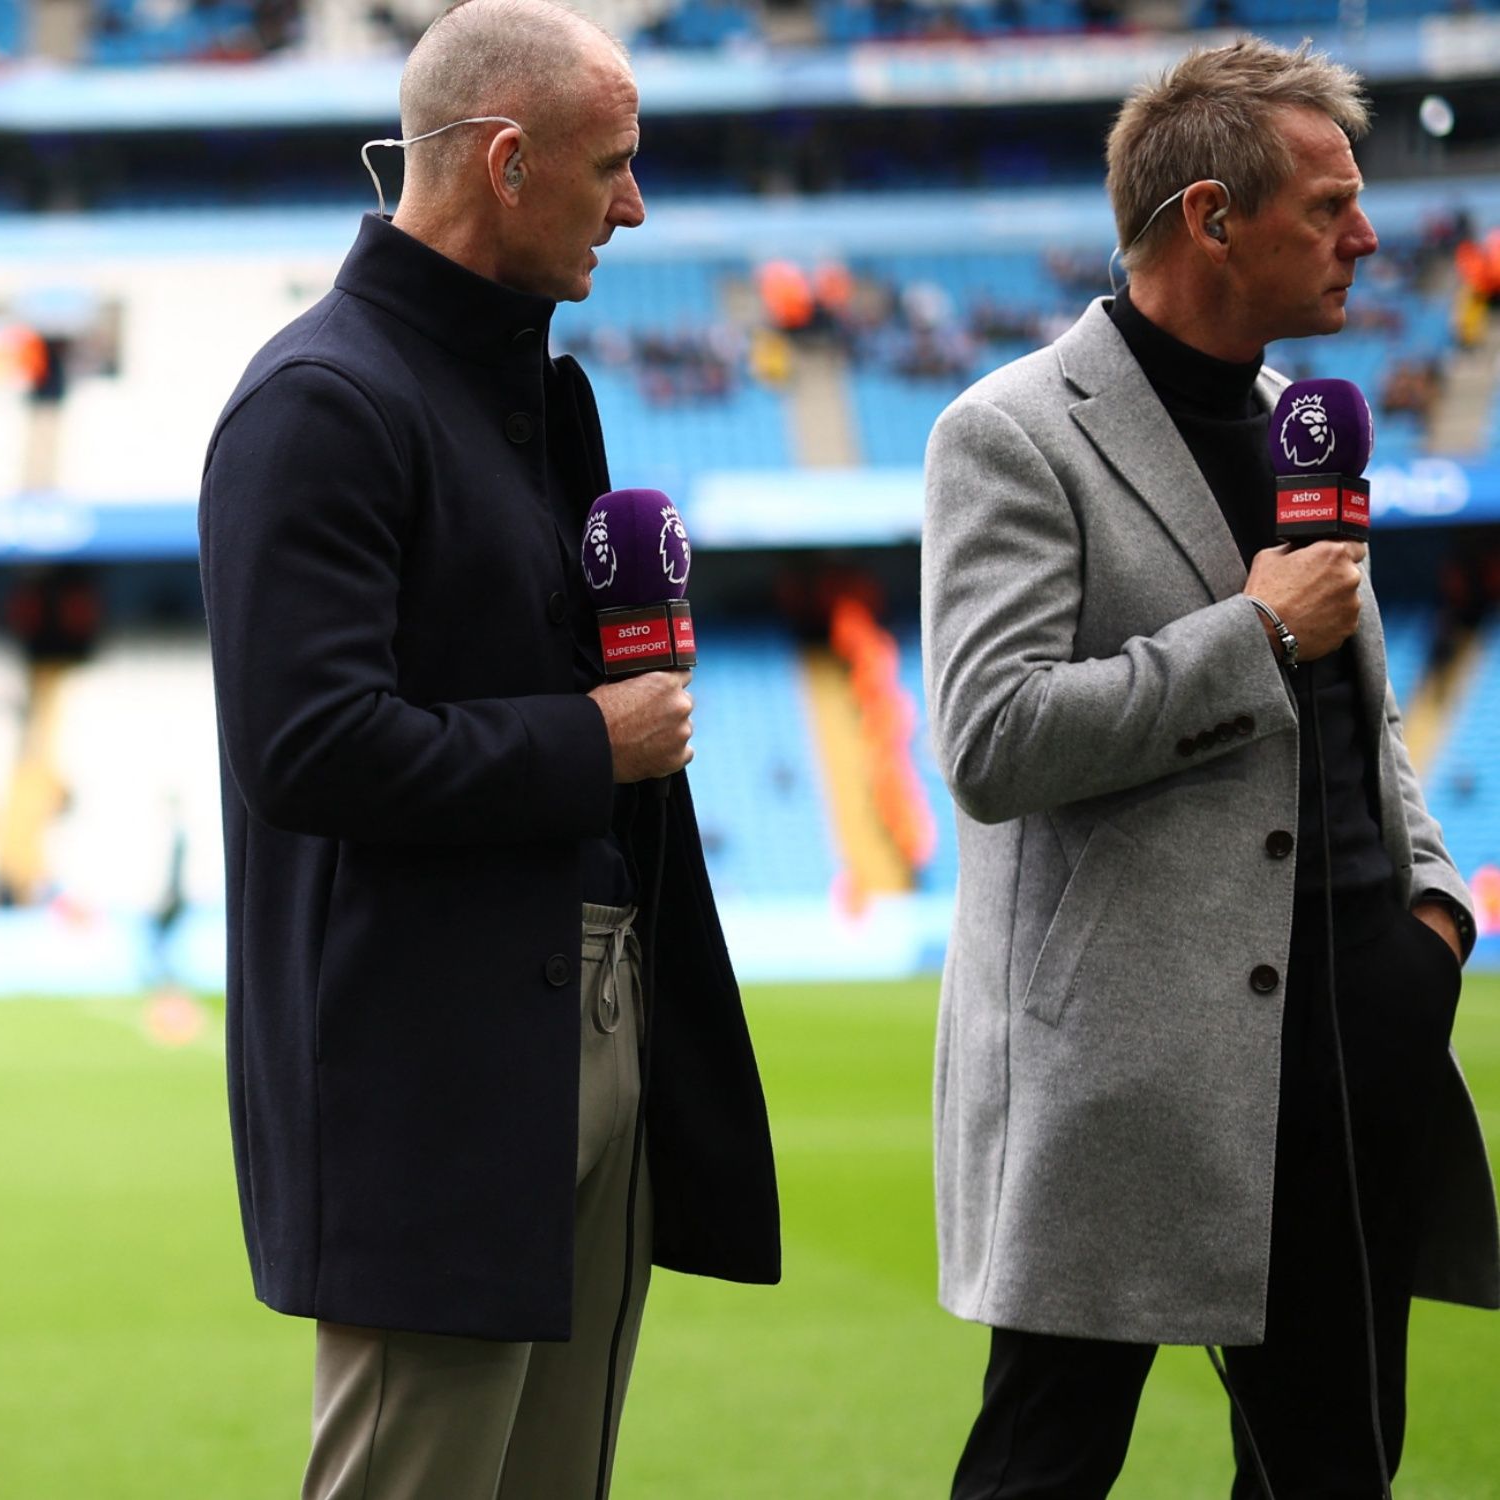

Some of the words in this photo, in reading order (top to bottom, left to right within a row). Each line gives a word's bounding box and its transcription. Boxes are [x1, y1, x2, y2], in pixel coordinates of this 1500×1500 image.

[1292, 491, 1321, 503] astro
[1280, 507, 1333, 519] SUPERSPORT
[618, 624, 651, 639] astro
[606, 639, 668, 658] SUPERSPORT
